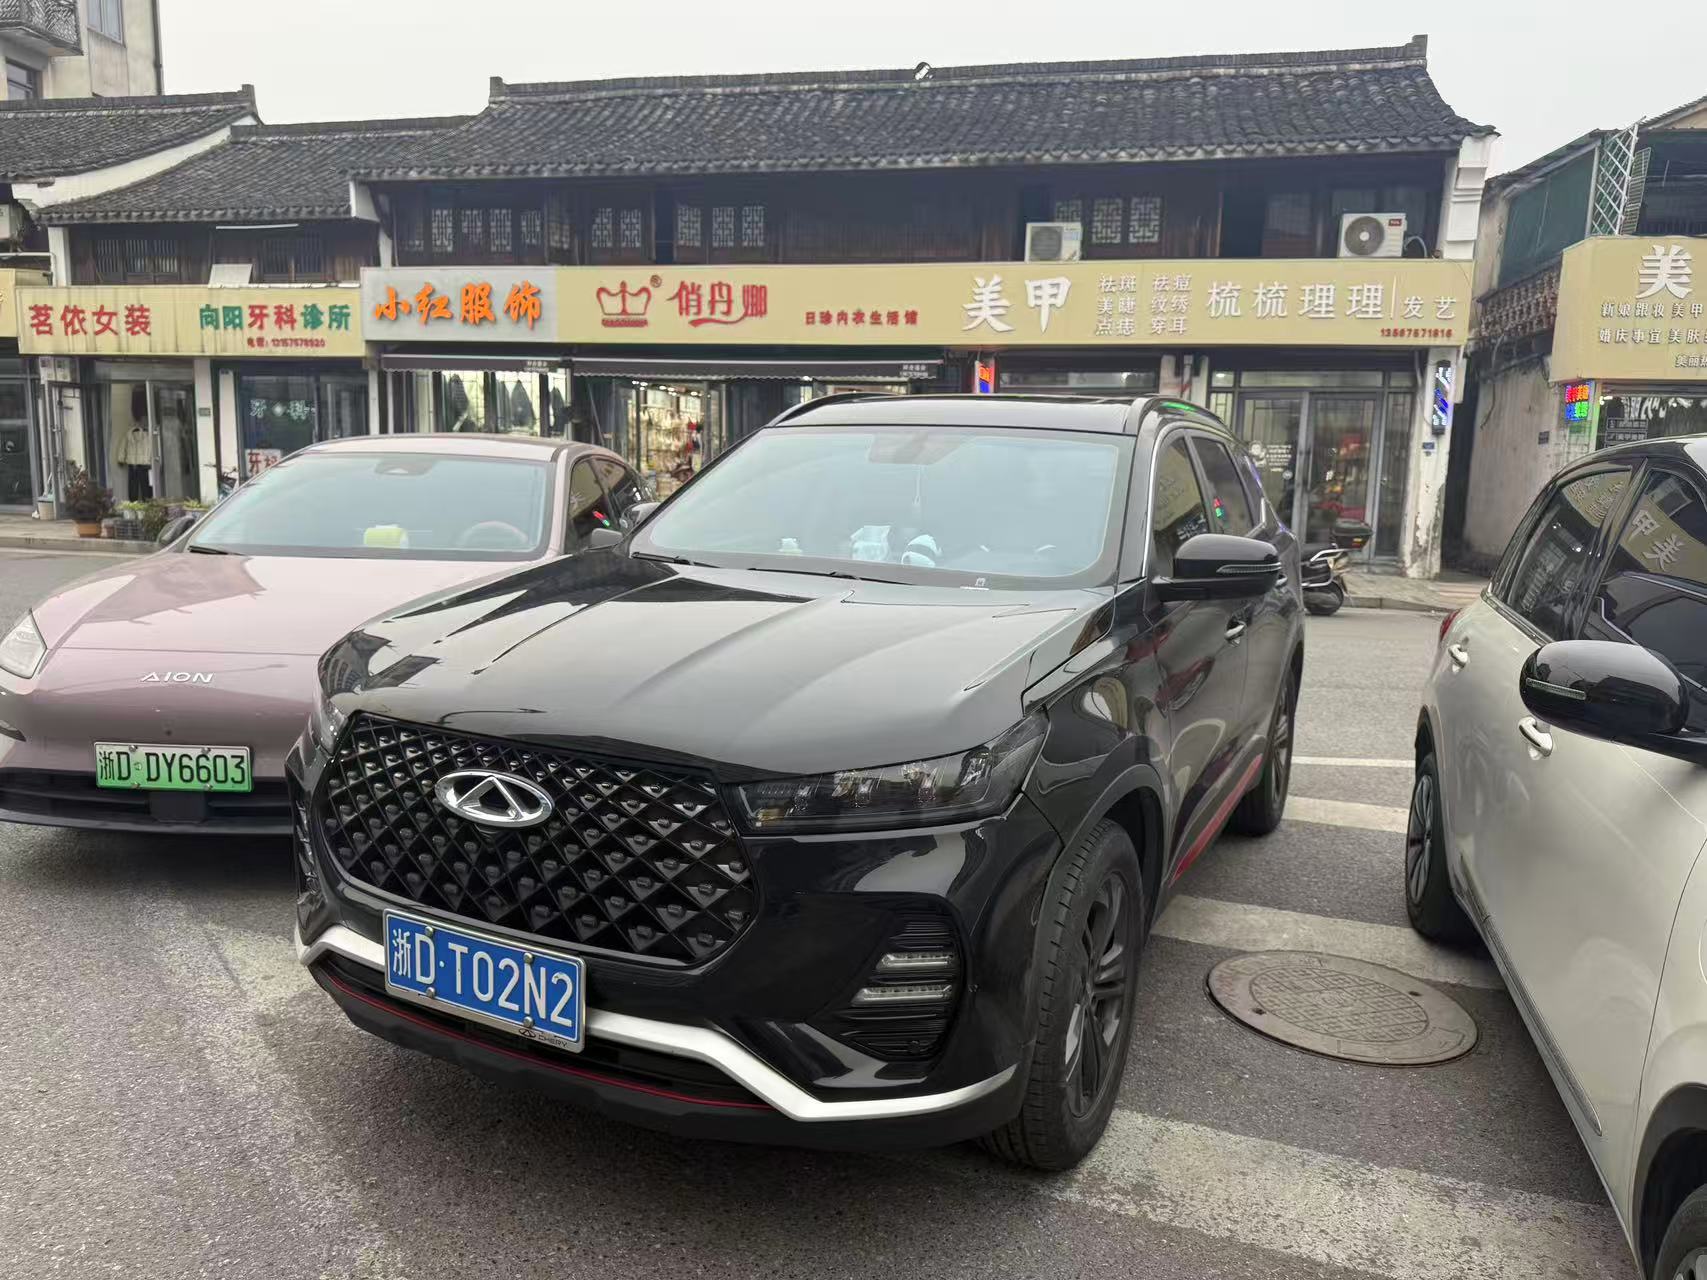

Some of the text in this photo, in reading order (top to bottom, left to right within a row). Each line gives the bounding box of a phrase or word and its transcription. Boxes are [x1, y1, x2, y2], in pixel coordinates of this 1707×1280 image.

[1099, 273, 1192, 293] 祛斑 祛痘
[1635, 245, 1693, 299] 美
[373, 280, 543, 331] 小红服饰
[962, 274, 1072, 334] 美甲
[1151, 296, 1190, 315] 纹绣
[1206, 281, 1457, 320] 梳梳理理 发艺
[1671, 303, 1703, 318] 美甲
[29, 303, 152, 337] 茗依女装
[199, 303, 351, 332] 向阳牙科诊所
[1095, 317, 1187, 337] 点痣 穿耳
[1599, 328, 1707, 345] 婚庆事宜 美肤
[140, 671, 214, 683] AION
